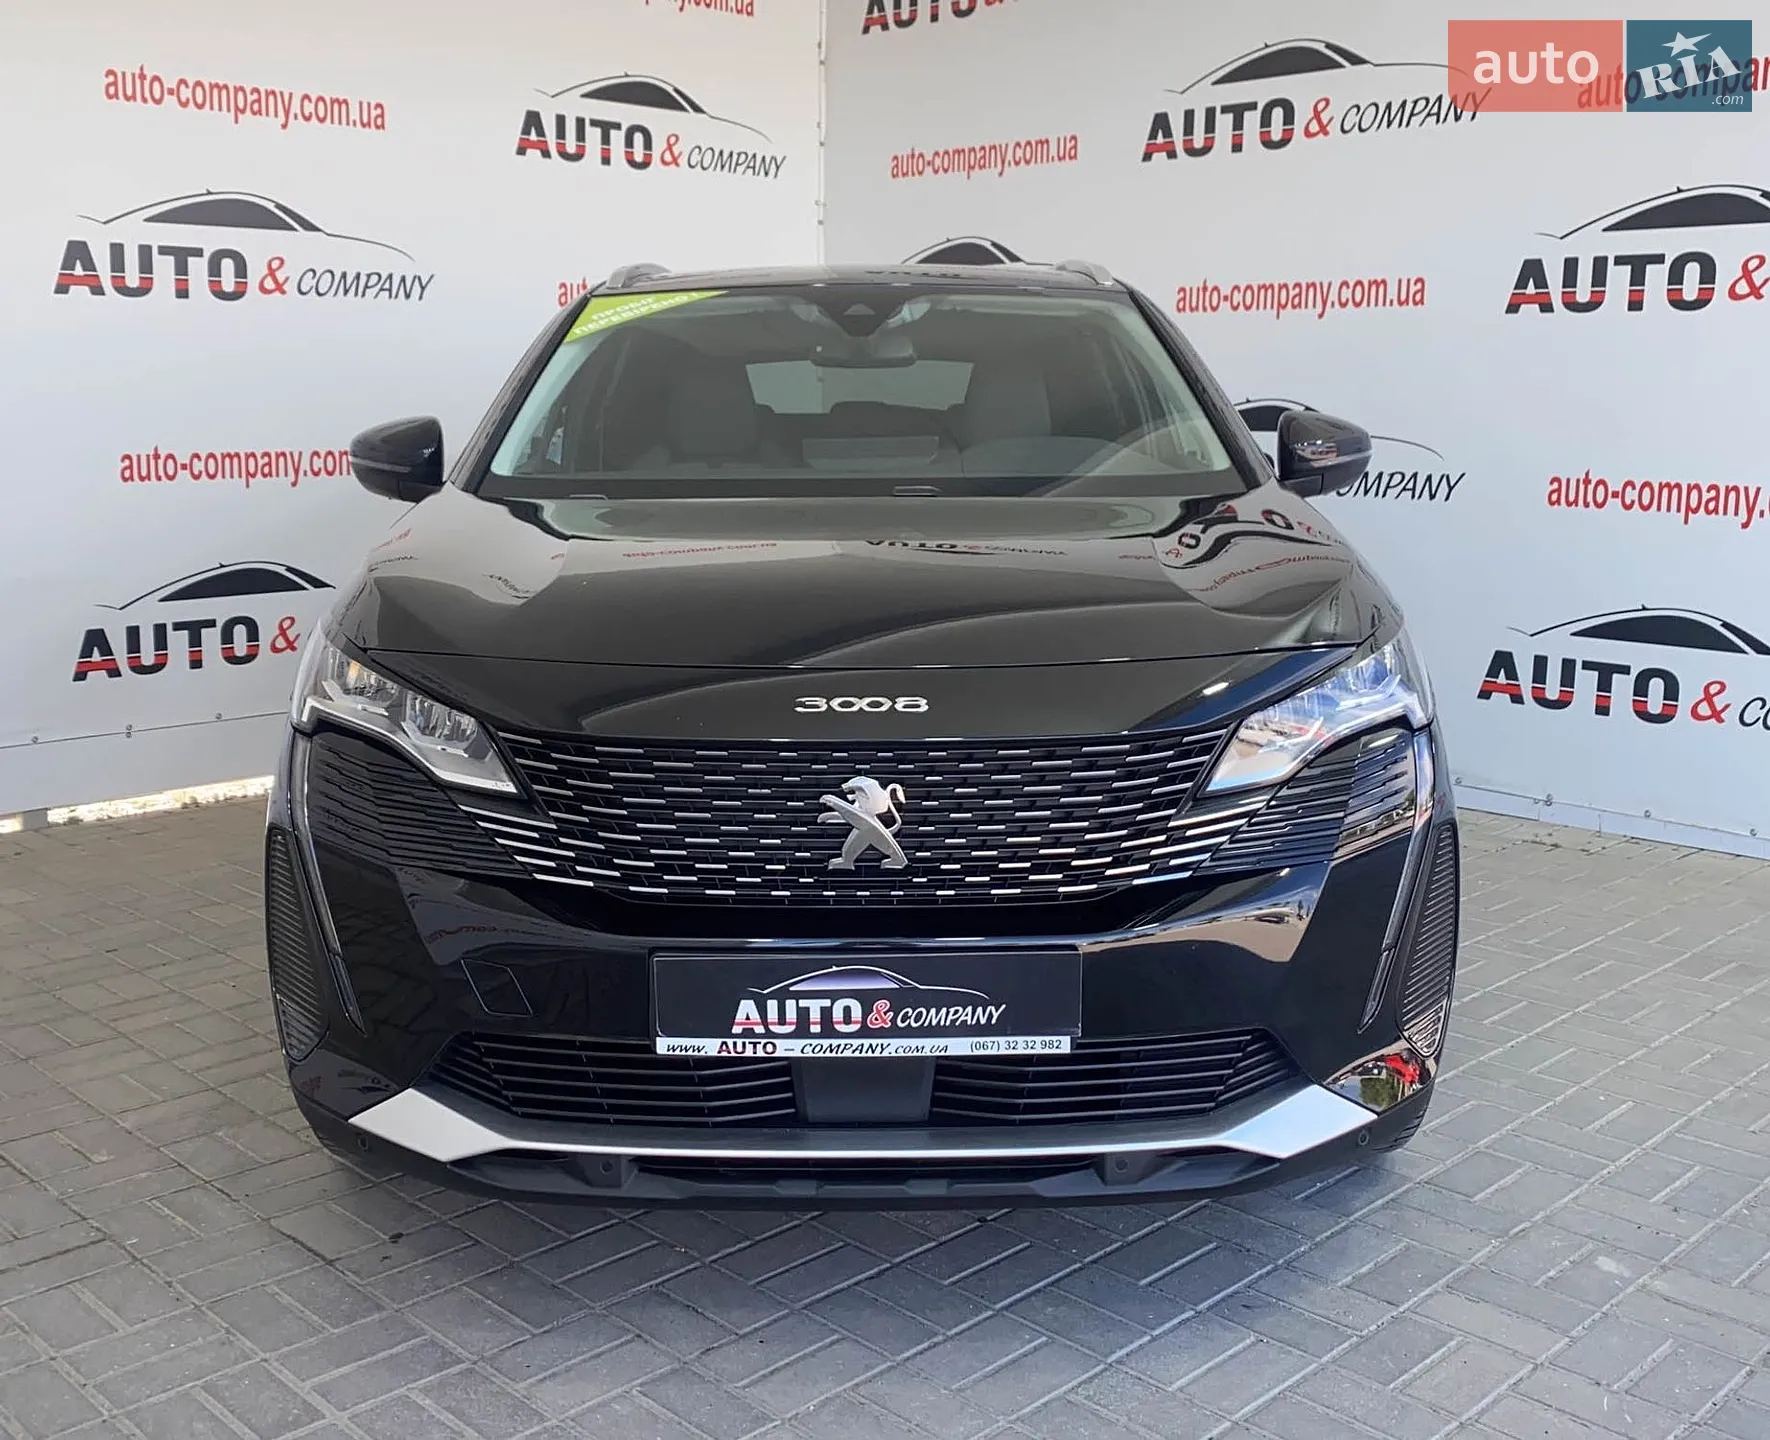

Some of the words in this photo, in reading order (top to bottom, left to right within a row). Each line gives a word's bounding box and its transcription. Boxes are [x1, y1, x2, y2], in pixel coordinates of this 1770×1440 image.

[103, 64, 386, 131] auto-company.com.ua
[1141, 97, 1295, 161] AUTO
[1303, 97, 1333, 138] &
[1339, 87, 1492, 133] COMPANY
[516, 110, 653, 170] AUTO
[660, 133, 682, 167] &
[687, 144, 786, 180] COMPANY
[890, 133, 1079, 180] auto-company.com.ua
[53, 239, 248, 301] AUTO
[258, 256, 289, 295] &
[297, 268, 434, 301] COMPANY
[1175, 275, 1427, 319] auto-company.com.ua
[1505, 251, 1717, 314] AUTO
[1728, 255, 1770, 301] &
[1547, 469, 1770, 529] auto-company.
[72, 615, 260, 682] AUTO
[270, 616, 300, 654] &
[794, 697, 929, 712] 3008
[1477, 649, 1680, 725] AUTO
[1690, 680, 1732, 724] &
[732, 999, 862, 1034] AUTO
[867, 1000, 892, 1028] &
[896, 1004, 1006, 1028] COMPANY
[970, 1040, 1001, 1053] (067)
[1004, 1040, 1019, 1050] 32
[1022, 1040, 1037, 1050] 32
[1040, 1039, 1062, 1049] 982
[717, 1041, 777, 1055] AUTO
